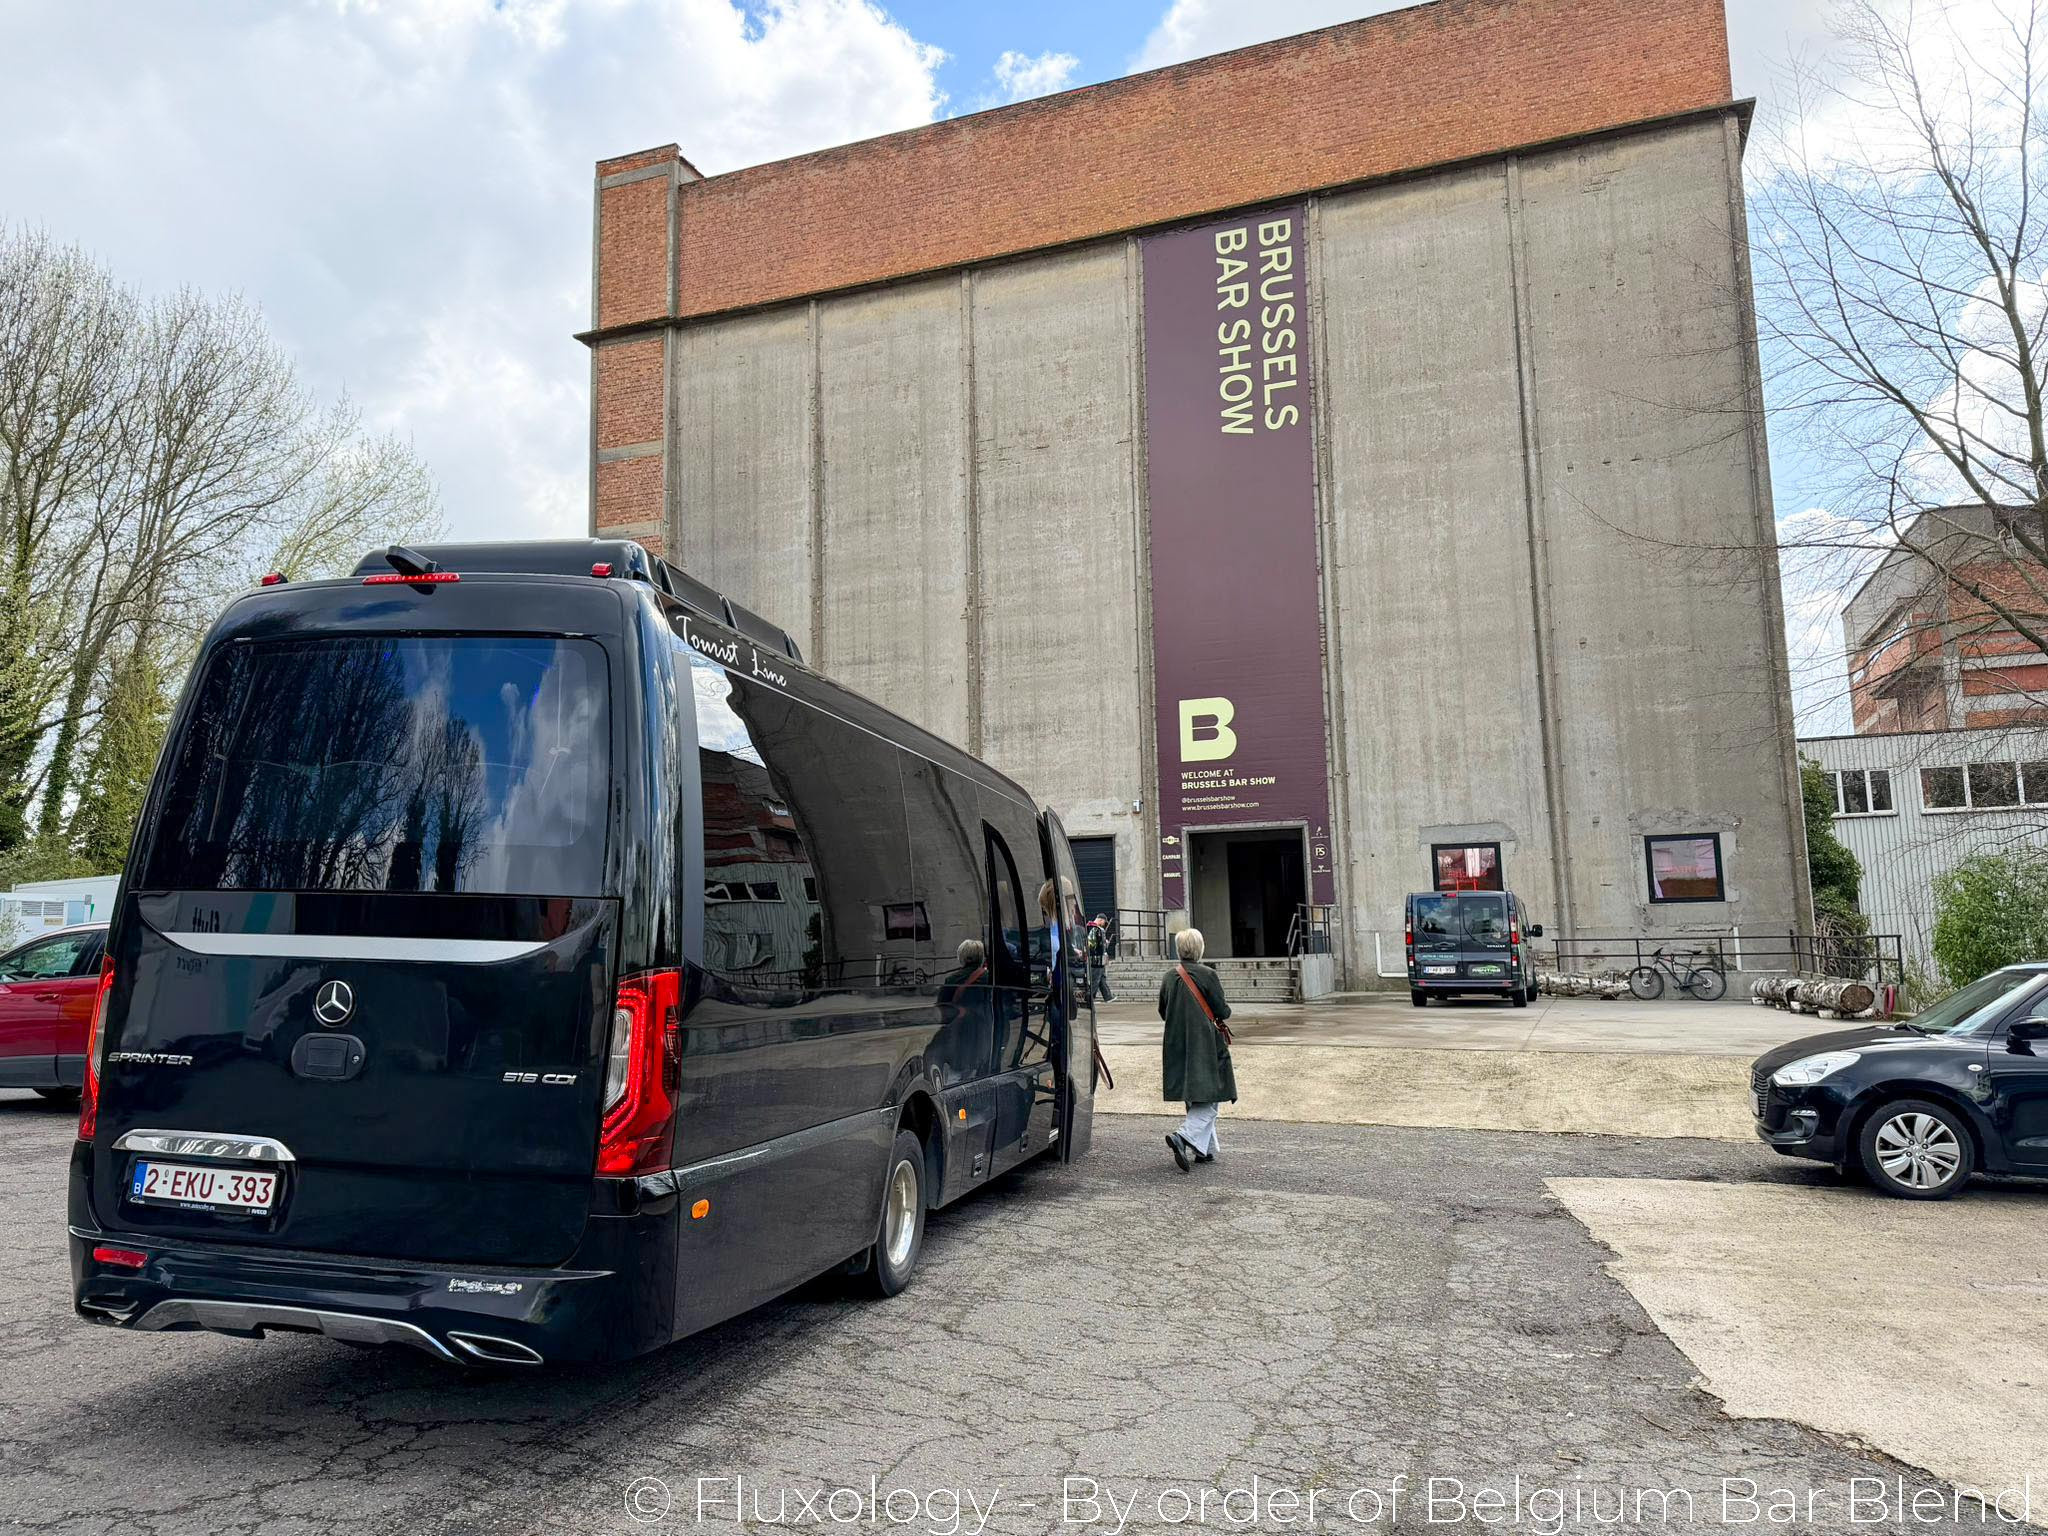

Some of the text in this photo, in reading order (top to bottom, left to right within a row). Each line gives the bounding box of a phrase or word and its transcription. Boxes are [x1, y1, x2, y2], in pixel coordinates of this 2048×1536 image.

[1215, 227, 1254, 434] BAR SHOW
[1258, 218, 1298, 430] BRUSSELS
[675, 614, 787, 687] Tourist Line
[1178, 696, 1237, 763] B
[1181, 768, 1234, 780] WELCOME AT
[1181, 776, 1276, 790] BRUSSELS BAR SHOW
[1181, 795, 1236, 804] @brusselsbarshow
[1181, 801, 1260, 812] www.brusselsbarshow.com
[107, 1051, 194, 1066] SPRINTER
[502, 1071, 577, 1086] 516 CDI
[133, 1182, 142, 1195] B
[251, 1208, 268, 1216] IVECO
